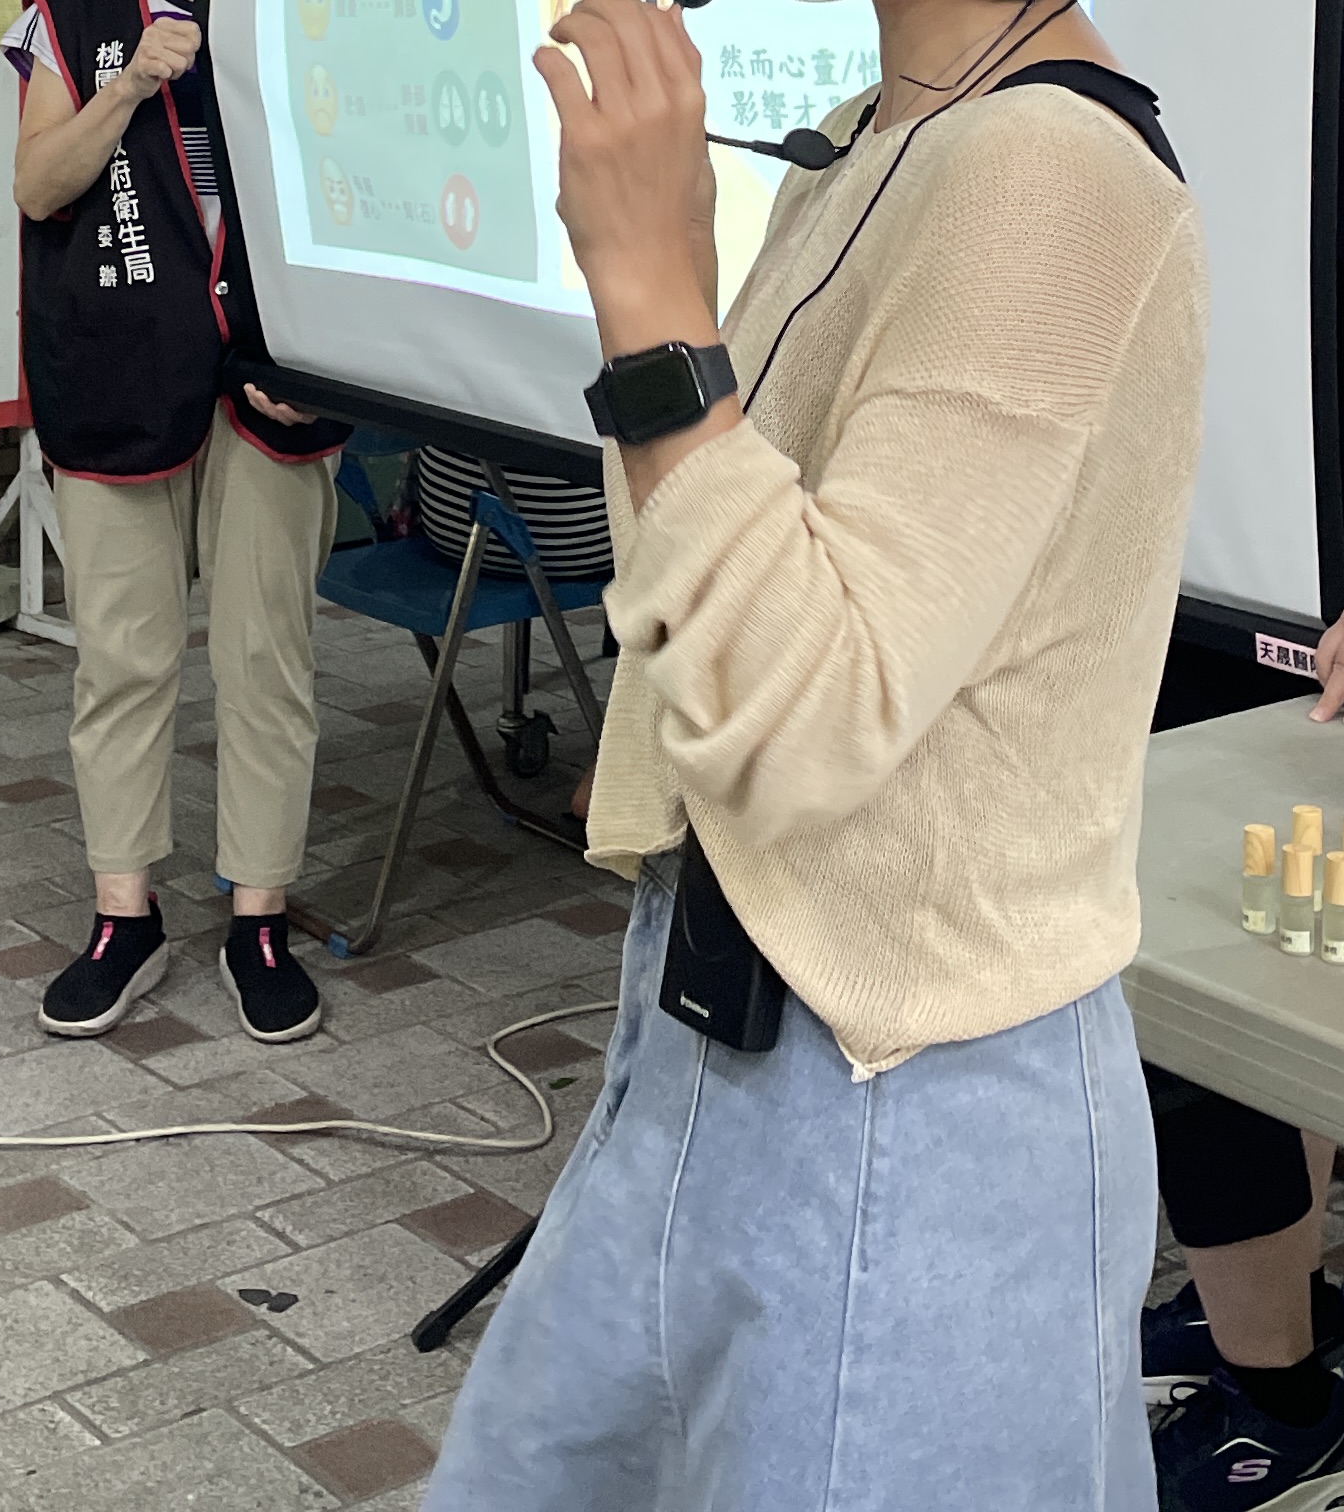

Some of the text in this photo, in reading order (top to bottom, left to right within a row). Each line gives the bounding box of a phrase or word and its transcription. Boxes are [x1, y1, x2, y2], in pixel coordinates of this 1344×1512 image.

[95, 40, 154, 285] 桃園府衛生局
